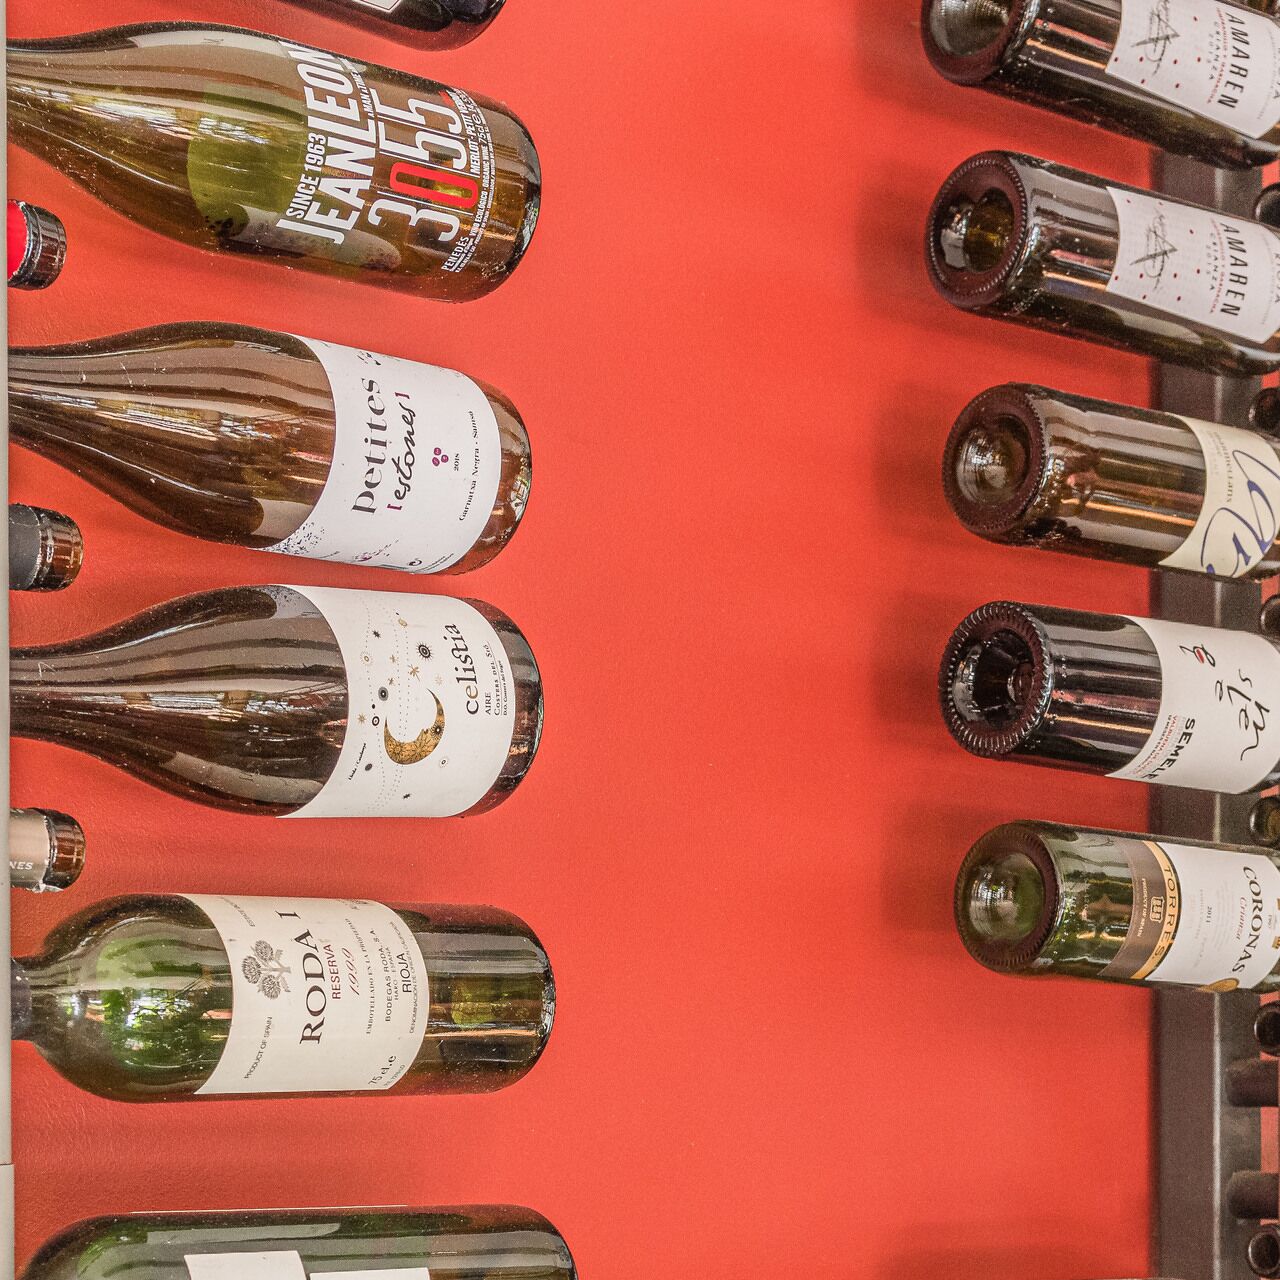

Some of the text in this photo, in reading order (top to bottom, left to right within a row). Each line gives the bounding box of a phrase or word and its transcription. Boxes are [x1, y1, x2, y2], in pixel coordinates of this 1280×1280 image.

[1217, 12, 1250, 108] AMAREN
[363, 92, 374, 112] MAN
[285, 131, 327, 220] SINCE 1963
[461, 113, 480, 174] MERLOT PETIT
[440, 235, 470, 271] PENEDÈS
[1219, 222, 1246, 315] AMAREN
[350, 377, 388, 514] petites
[452, 452, 460, 471] 2018
[458, 478, 477, 521] Garnatxa
[471, 447, 480, 477] Negra
[449, 622, 480, 716] celistia
[500, 683, 508, 702] Costers
[483, 691, 492, 715] AIRE
[1153, 867, 1175, 956] TORRES
[1232, 865, 1263, 972] CORONAS
[292, 927, 327, 1044] RODA
[322, 943, 341, 1000] RESERVA
[340, 946, 361, 996] 1999
[343, 917, 376, 1035] EMBOTELLADO EN LA PROPIEDAD
[383, 975, 393, 1022] BODEGAS
[395, 951, 412, 993] RIOJA
[243, 1015, 273, 1079] PRODUCT OF SPAIN
